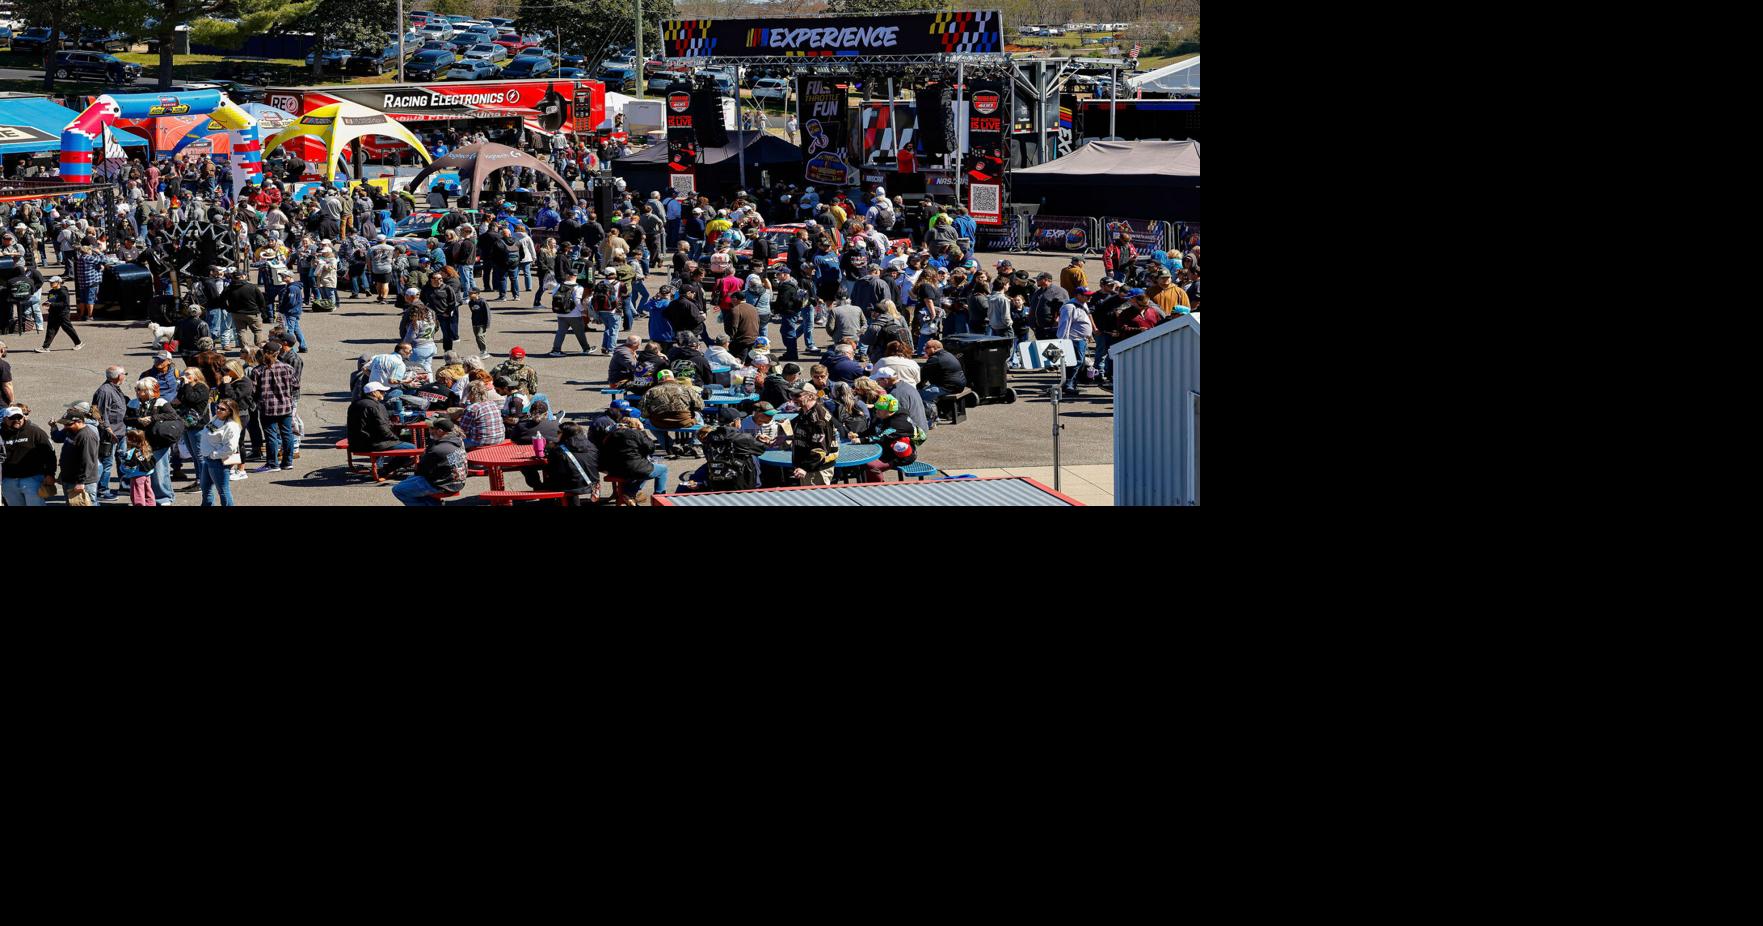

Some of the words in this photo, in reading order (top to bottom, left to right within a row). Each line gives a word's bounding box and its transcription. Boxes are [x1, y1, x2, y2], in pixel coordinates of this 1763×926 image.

[769, 26, 900, 48] EXPERIENCE
[806, 81, 831, 95] FUL
[384, 94, 427, 108] RACING
[430, 92, 504, 107] ELECTRONICS
[805, 94, 840, 102] THROTTLE
[813, 101, 838, 116] FUN
[675, 118, 692, 126] LIVE
[980, 121, 1000, 130] LIVE
